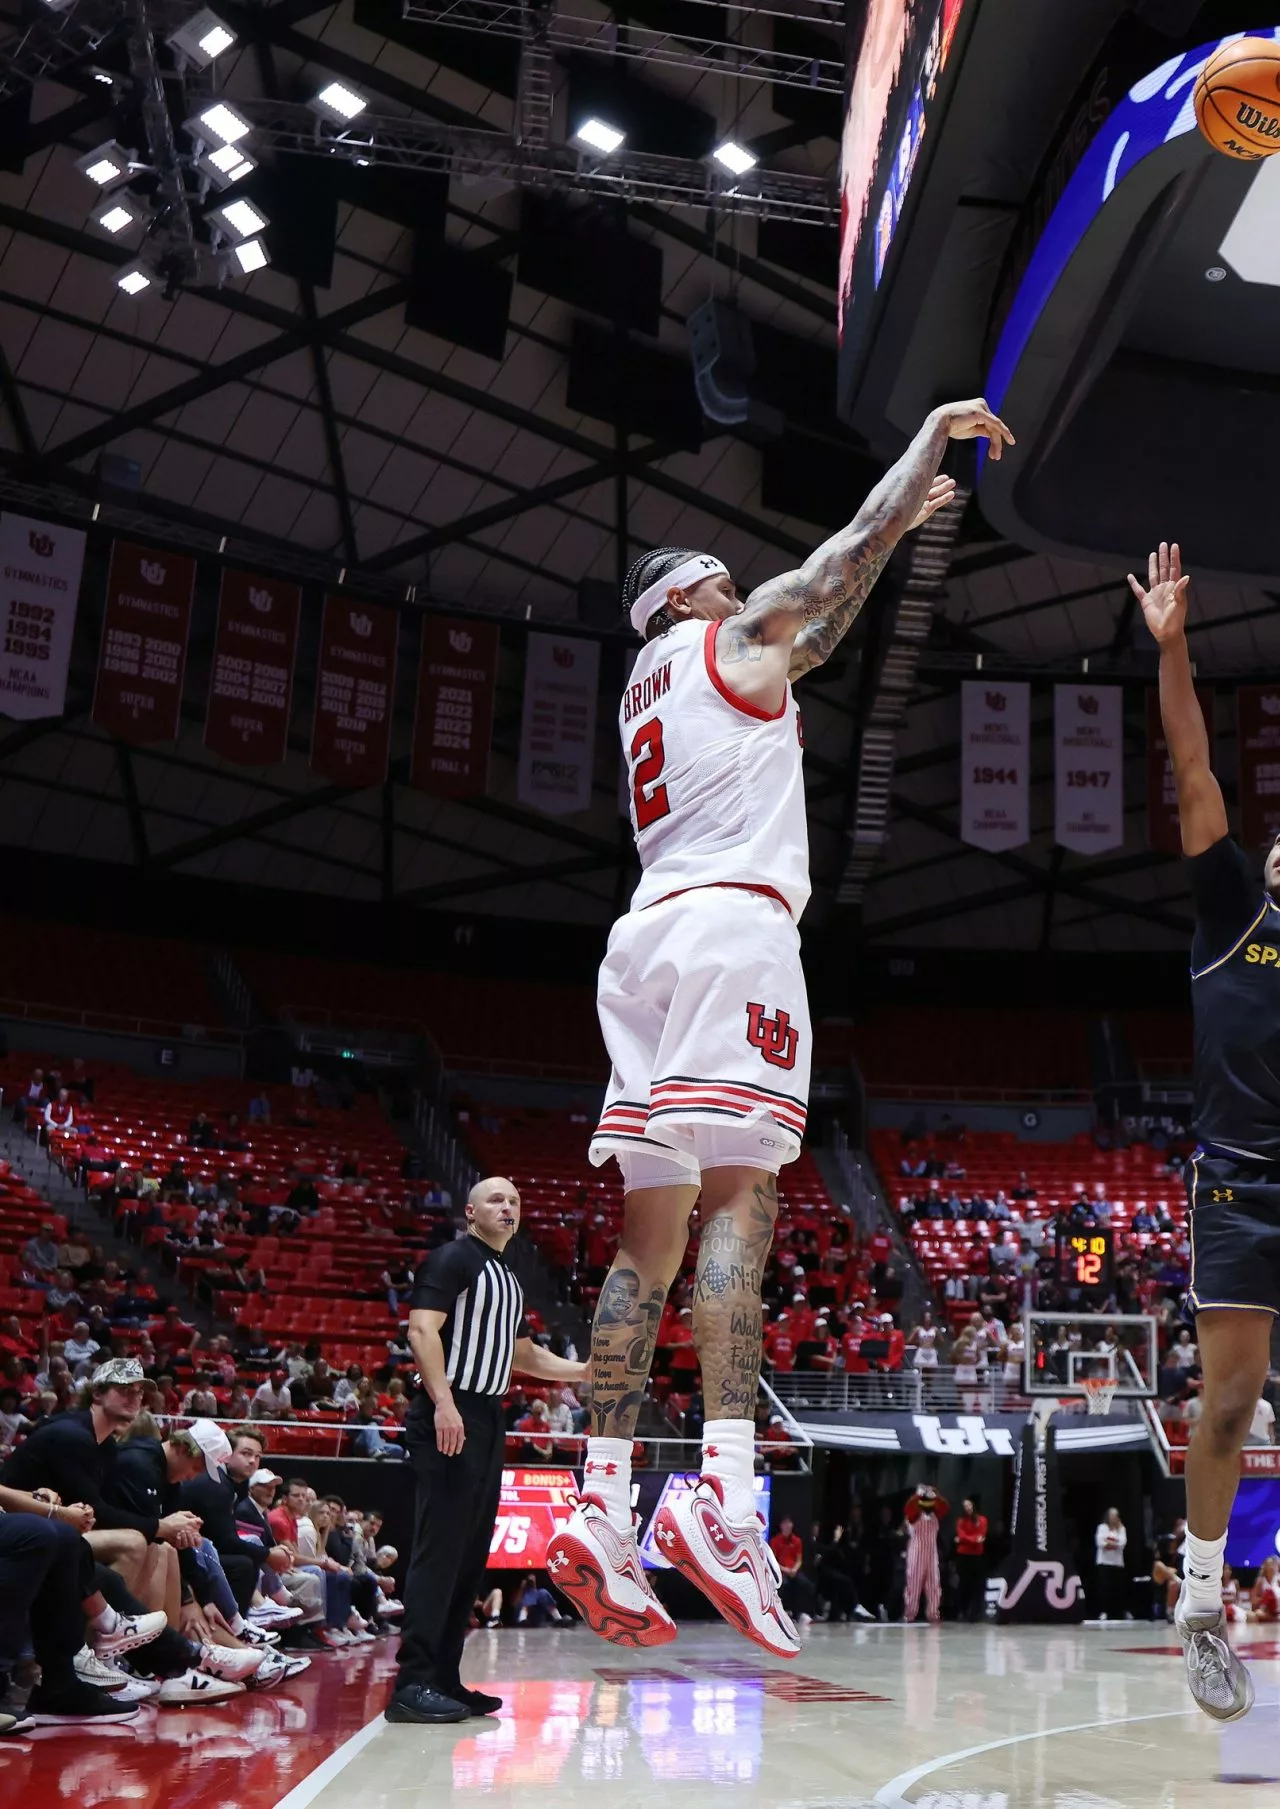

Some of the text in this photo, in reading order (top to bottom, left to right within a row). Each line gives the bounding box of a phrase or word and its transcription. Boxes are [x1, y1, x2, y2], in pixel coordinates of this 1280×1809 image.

[4, 566, 69, 591] GYMNASTICS
[117, 593, 180, 619] GYMNASTICS
[6, 618, 52, 642] 1994
[228, 619, 287, 645] GYMNASTICS
[0, 678, 49, 699] HAMPIONS
[624, 660, 673, 724] BROWN
[630, 716, 671, 832] 2
[973, 766, 1018, 785] 1944
[1066, 770, 1111, 788] 1947
[703, 1219, 732, 1236] UST
[1070, 1236, 1106, 1255] 4:10
[1076, 1253, 1102, 1285] 12
[603, 1355, 626, 1364] game
[1245, 1453, 1276, 1468] THE
[523, 1473, 571, 1486] BONUS+
[1035, 1457, 1048, 1493] FIRST
[1036, 1494, 1048, 1551] AMERICA
[489, 1516, 532, 1554] 75
